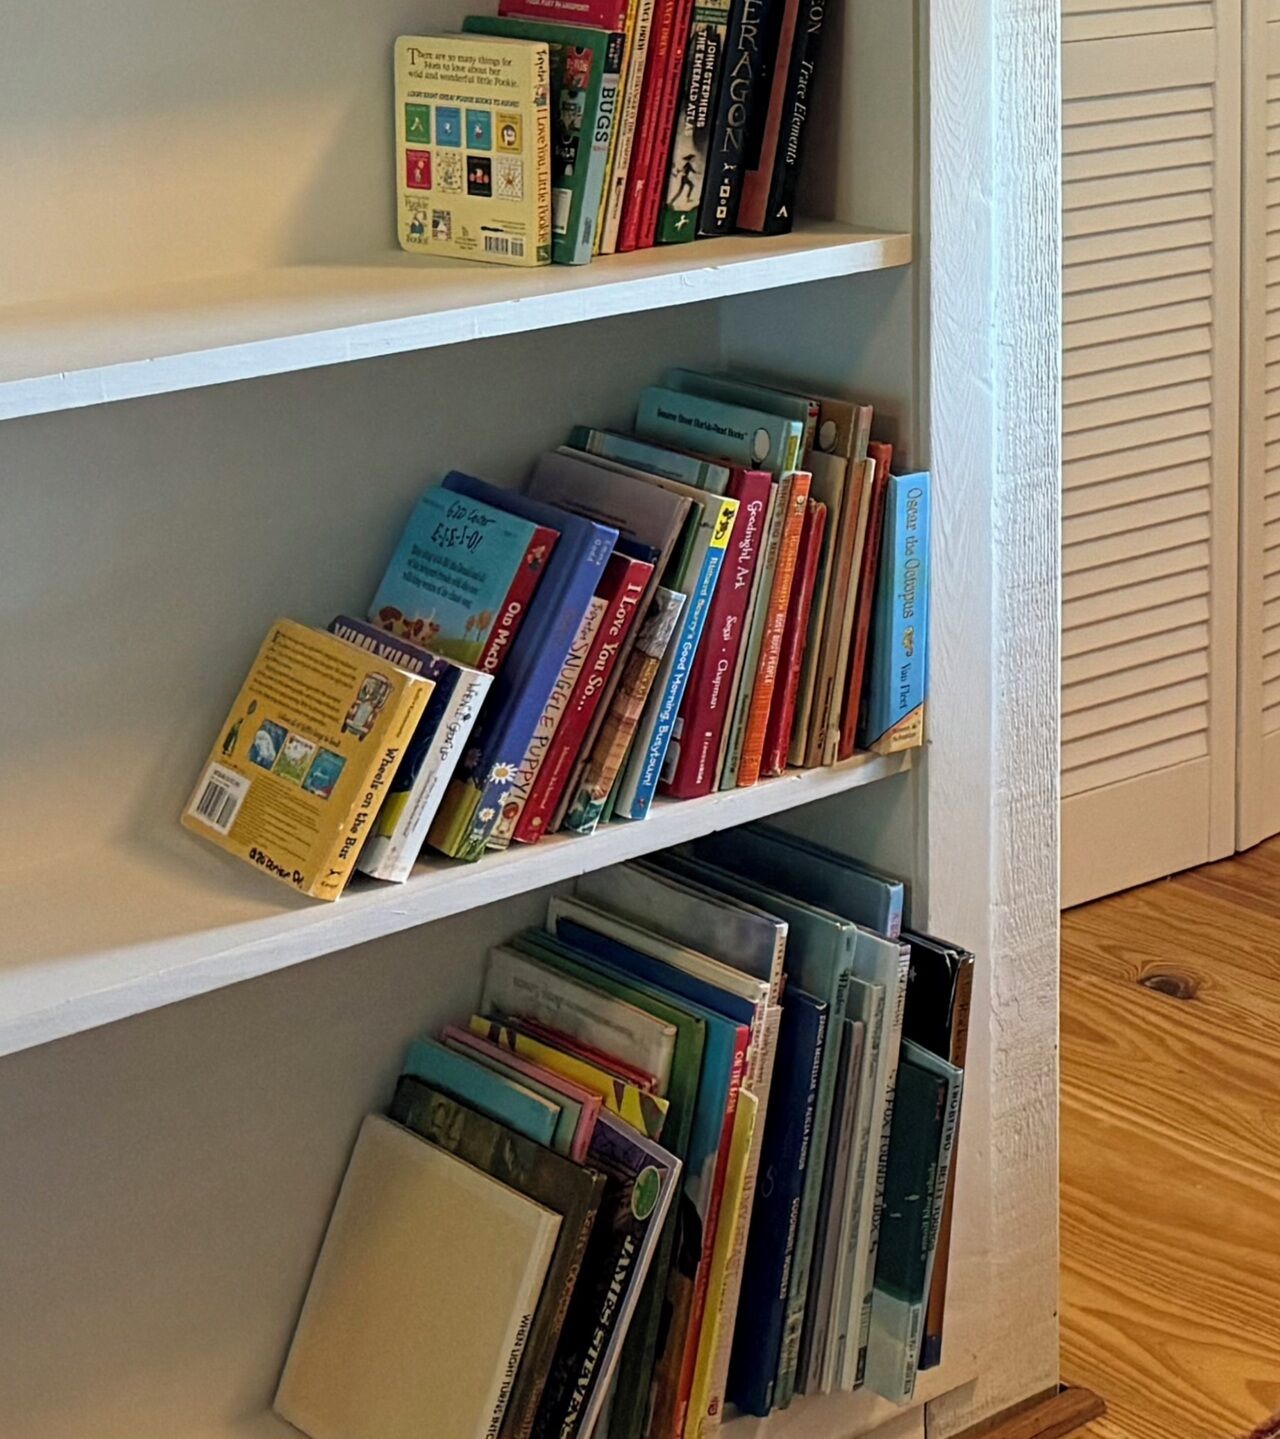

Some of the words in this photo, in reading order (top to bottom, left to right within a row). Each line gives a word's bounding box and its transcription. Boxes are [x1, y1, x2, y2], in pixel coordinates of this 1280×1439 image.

[697, 30, 707, 50] THE
[706, 41, 717, 71] JOHN
[688, 53, 704, 101] EMERALD
[798, 61, 814, 99] Trace
[596, 88, 615, 144] BUGS
[696, 72, 713, 128] STEPHENS
[538, 116, 548, 142] Love
[786, 104, 806, 166] Elements
[540, 173, 549, 202] Little
[540, 206, 550, 242] Pookie
[907, 488, 922, 531] Oscar
[596, 540, 611, 567] Emma
[906, 536, 917, 557] the
[701, 557, 719, 596] Richard
[735, 567, 748, 591] Ark
[900, 558, 918, 619] Octopus
[610, 596, 636, 638] Love
[688, 596, 707, 640] Scarry's
[596, 640, 618, 673] You
[679, 642, 693, 670] Good
[902, 665, 910, 682] Van
[540, 639, 589, 731] SNUGGLE
[662, 672, 683, 724] Morning,
[708, 659, 728, 710] Chapman
[900, 687, 910, 709] Fleet
[371, 746, 398, 792] Wheels
[510, 733, 549, 801] PUPPY!
[642, 725, 668, 788] Busytown!
[362, 792, 375, 809] on
[350, 812, 368, 835] the
[339, 837, 356, 861] Bus
[884, 1099, 893, 1127] FOX
[877, 1134, 888, 1184] FOUND
[871, 1205, 882, 1234] BOX
[600, 1235, 637, 1326] JAMES
[516, 1314, 531, 1348] WHEN
[506, 1348, 519, 1379] LIGHT
[494, 1381, 510, 1416] TURNS
